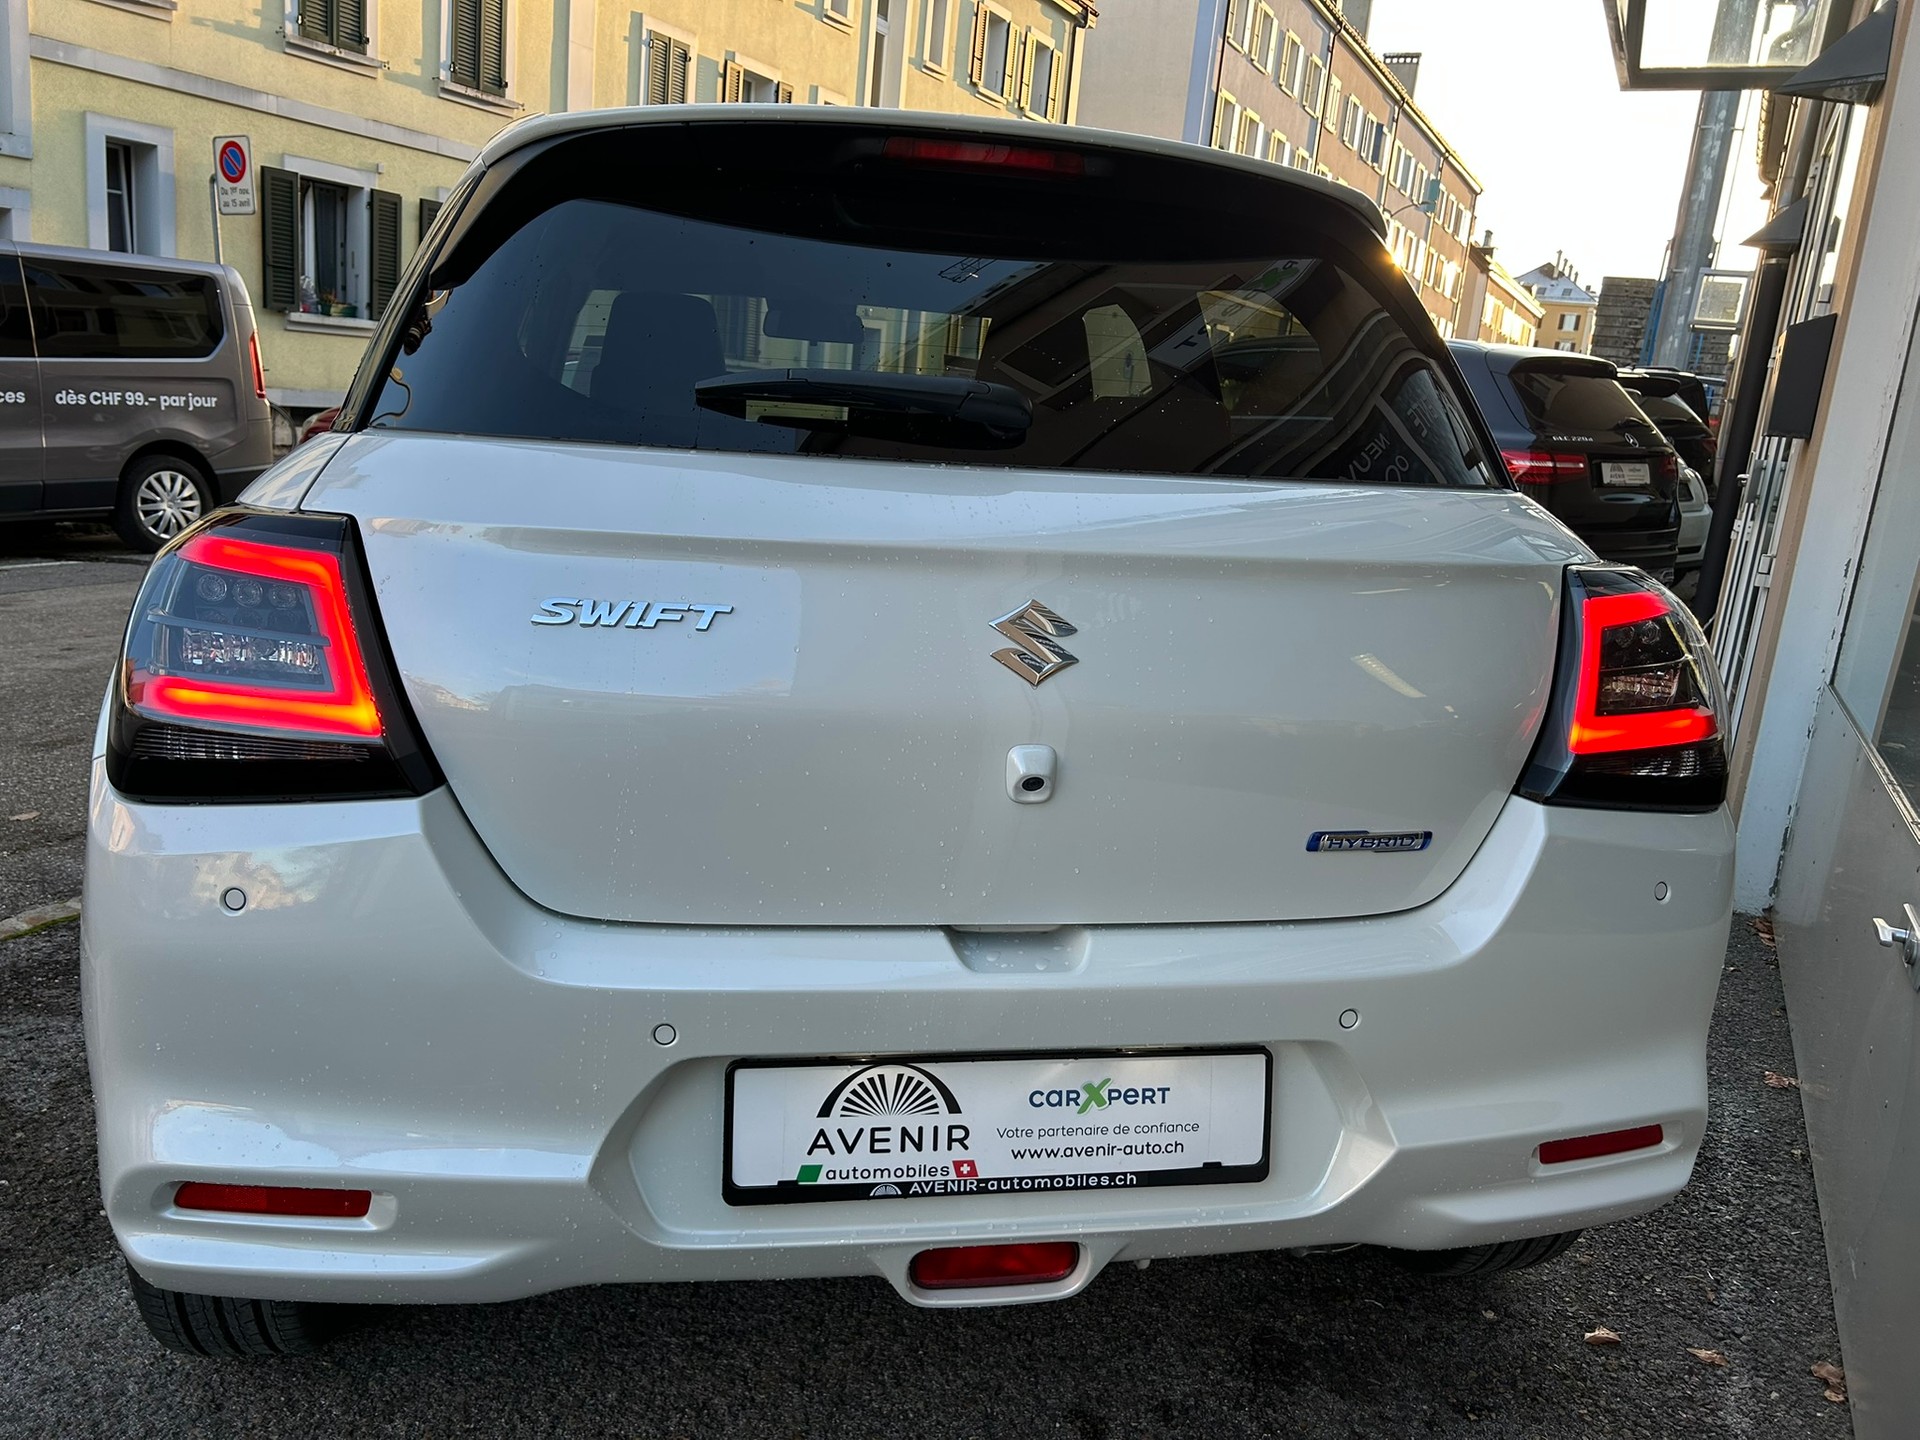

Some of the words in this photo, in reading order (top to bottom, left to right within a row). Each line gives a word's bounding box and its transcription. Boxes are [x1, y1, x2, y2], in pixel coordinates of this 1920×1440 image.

[231, 199, 238, 207] 15
[55, 389, 87, 405] dès
[89, 391, 122, 406] CHF
[160, 394, 186, 410] par
[187, 393, 218, 411] jour
[530, 597, 734, 632] SWIFT
[1327, 835, 1417, 849] HYBRID
[806, 1124, 970, 1156] AVENIR
[996, 1127, 1034, 1139] Votre
[1038, 1123, 1109, 1140] partenaire
[1113, 1123, 1131, 1135] de
[1134, 1121, 1200, 1134] confiance
[1011, 1140, 1184, 1159] www.avenir-auto.ch
[825, 1164, 950, 1181] automobiles
[909, 1173, 1137, 1194] AVENIR-automobiles.ch
